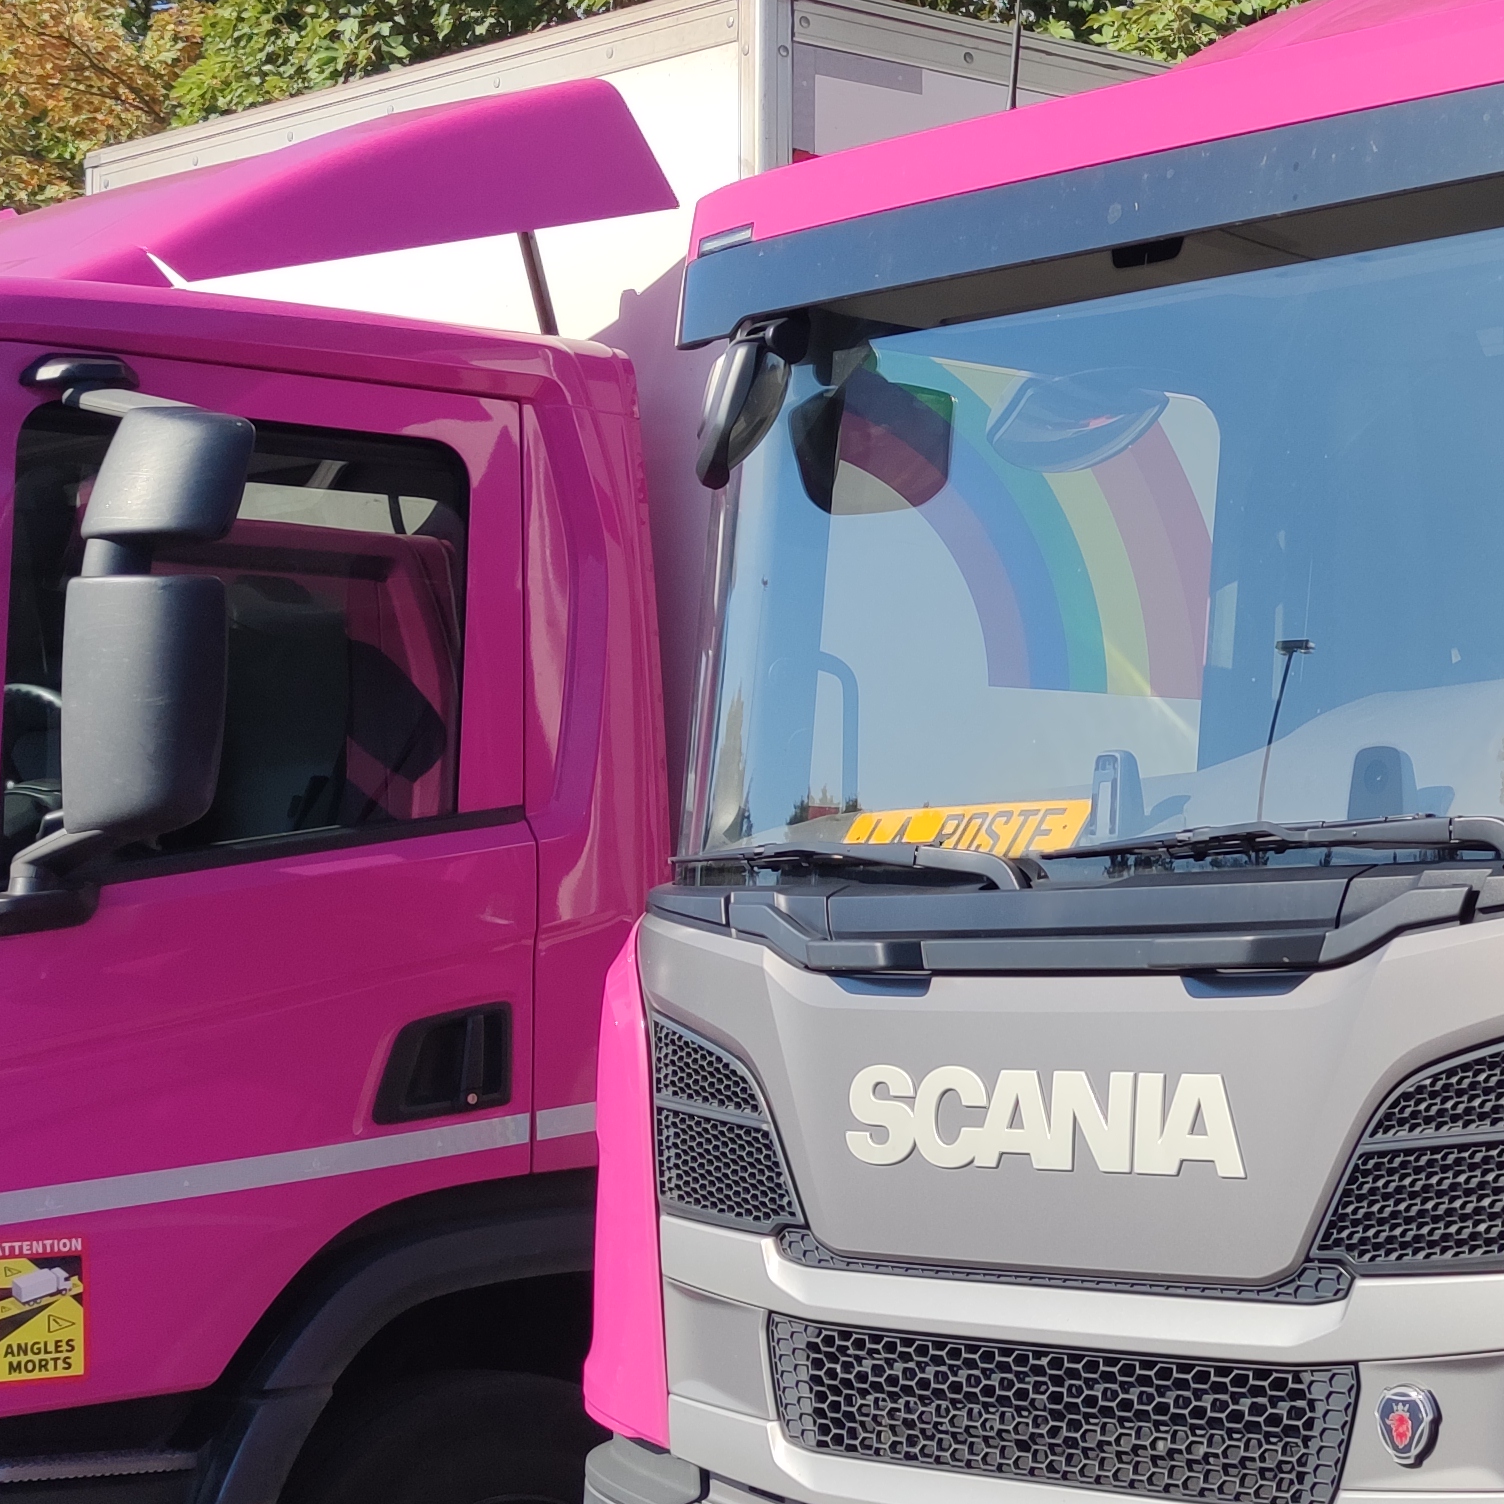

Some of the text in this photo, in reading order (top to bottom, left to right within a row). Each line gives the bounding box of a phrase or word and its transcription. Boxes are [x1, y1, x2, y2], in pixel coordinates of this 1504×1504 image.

[844, 1065, 1248, 1181] SCANIA
[3, 1338, 76, 1358] ANGLES
[7, 1356, 73, 1375] MORTS
